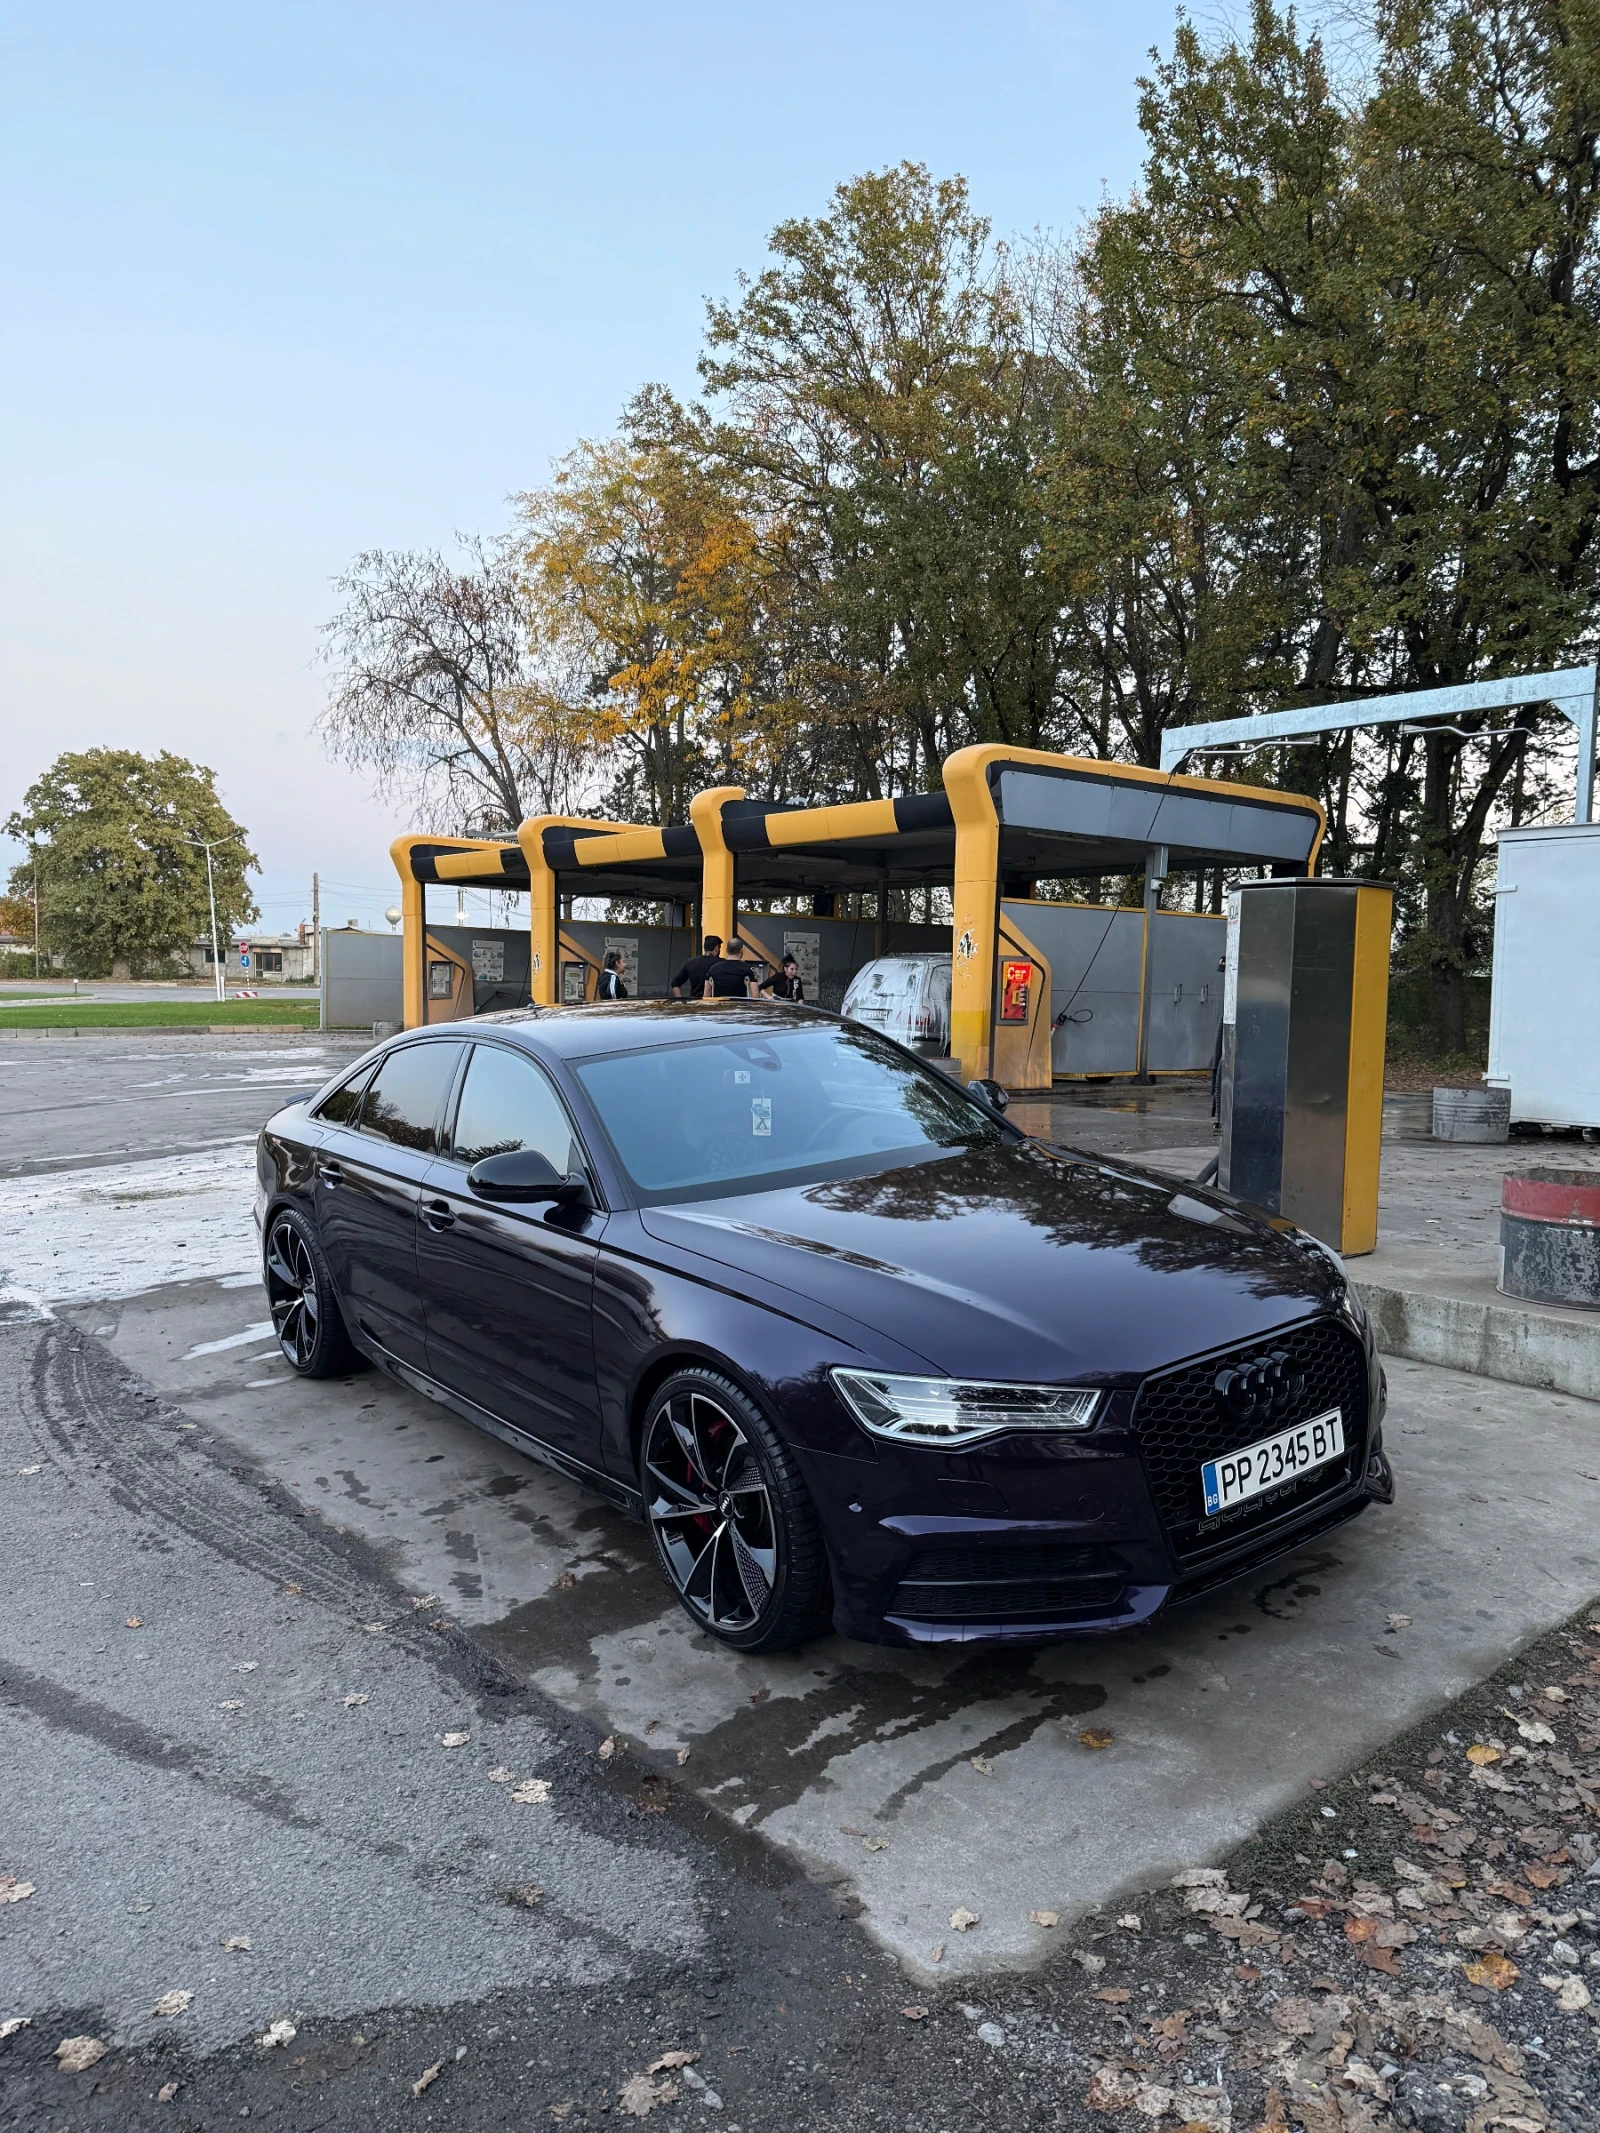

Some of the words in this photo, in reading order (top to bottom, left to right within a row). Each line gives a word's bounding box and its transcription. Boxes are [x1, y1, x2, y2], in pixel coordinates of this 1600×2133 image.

[1221, 1456, 1252, 1500] PP
[1257, 1431, 1309, 1485] 2345
[1312, 1417, 1337, 1459] BT
[1207, 1494, 1219, 1507] BG
